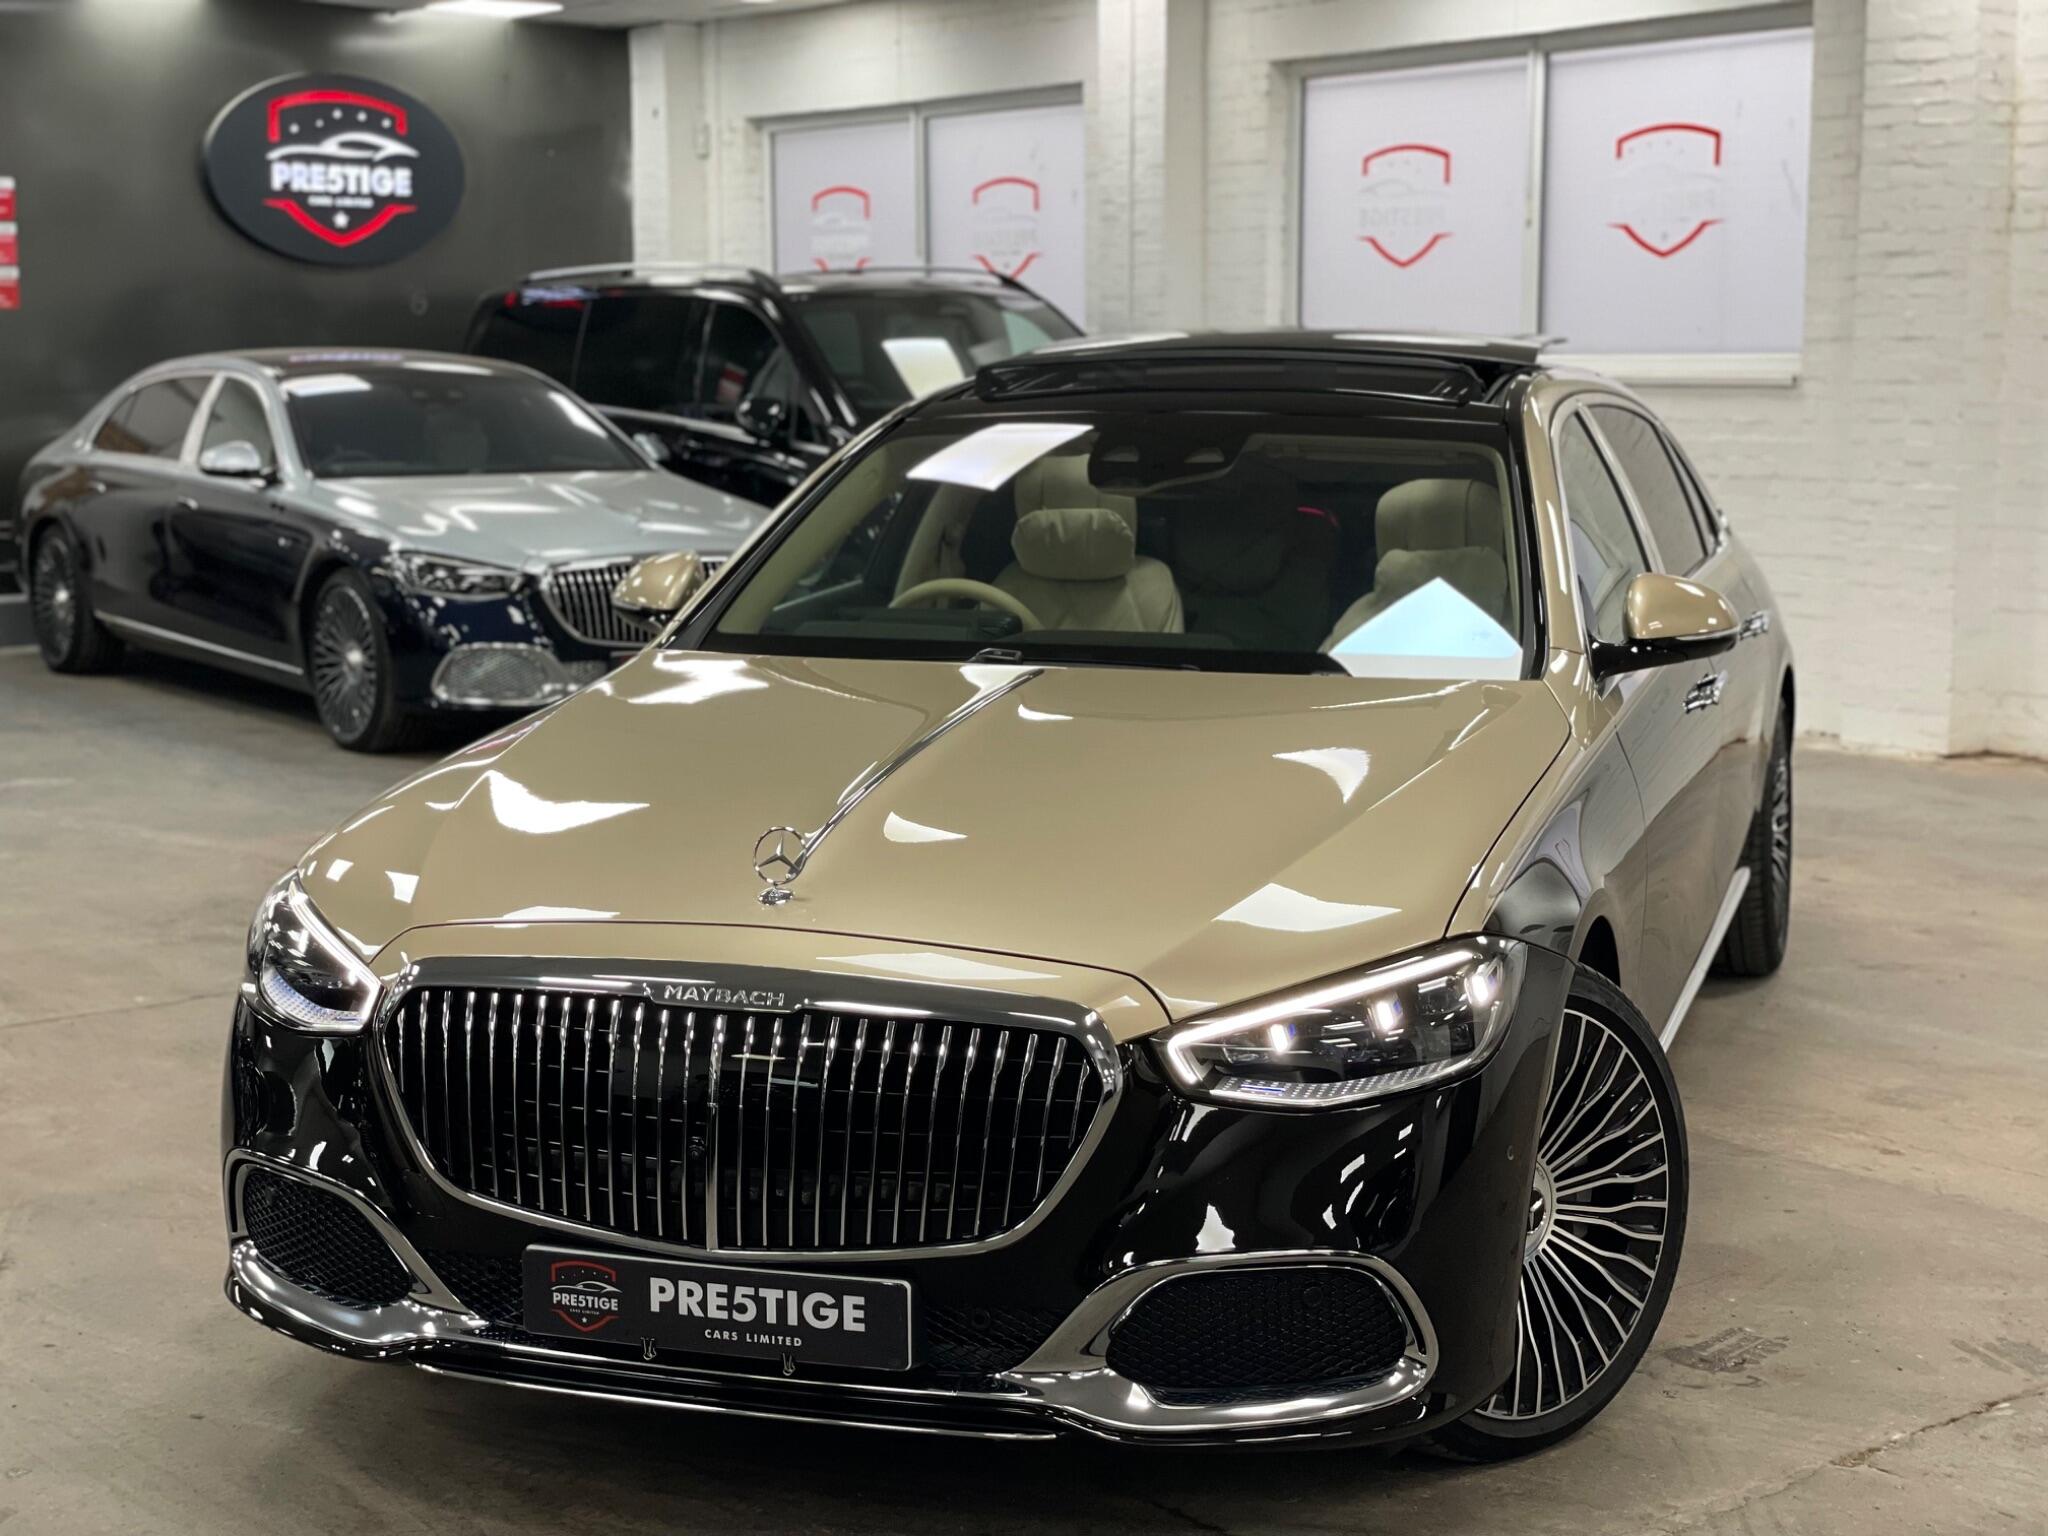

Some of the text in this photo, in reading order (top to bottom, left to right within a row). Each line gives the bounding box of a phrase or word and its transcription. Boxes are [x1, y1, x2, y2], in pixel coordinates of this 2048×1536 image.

[663, 984, 785, 1007] MAYBACH
[704, 1329, 802, 1347] CARS LIMITED
